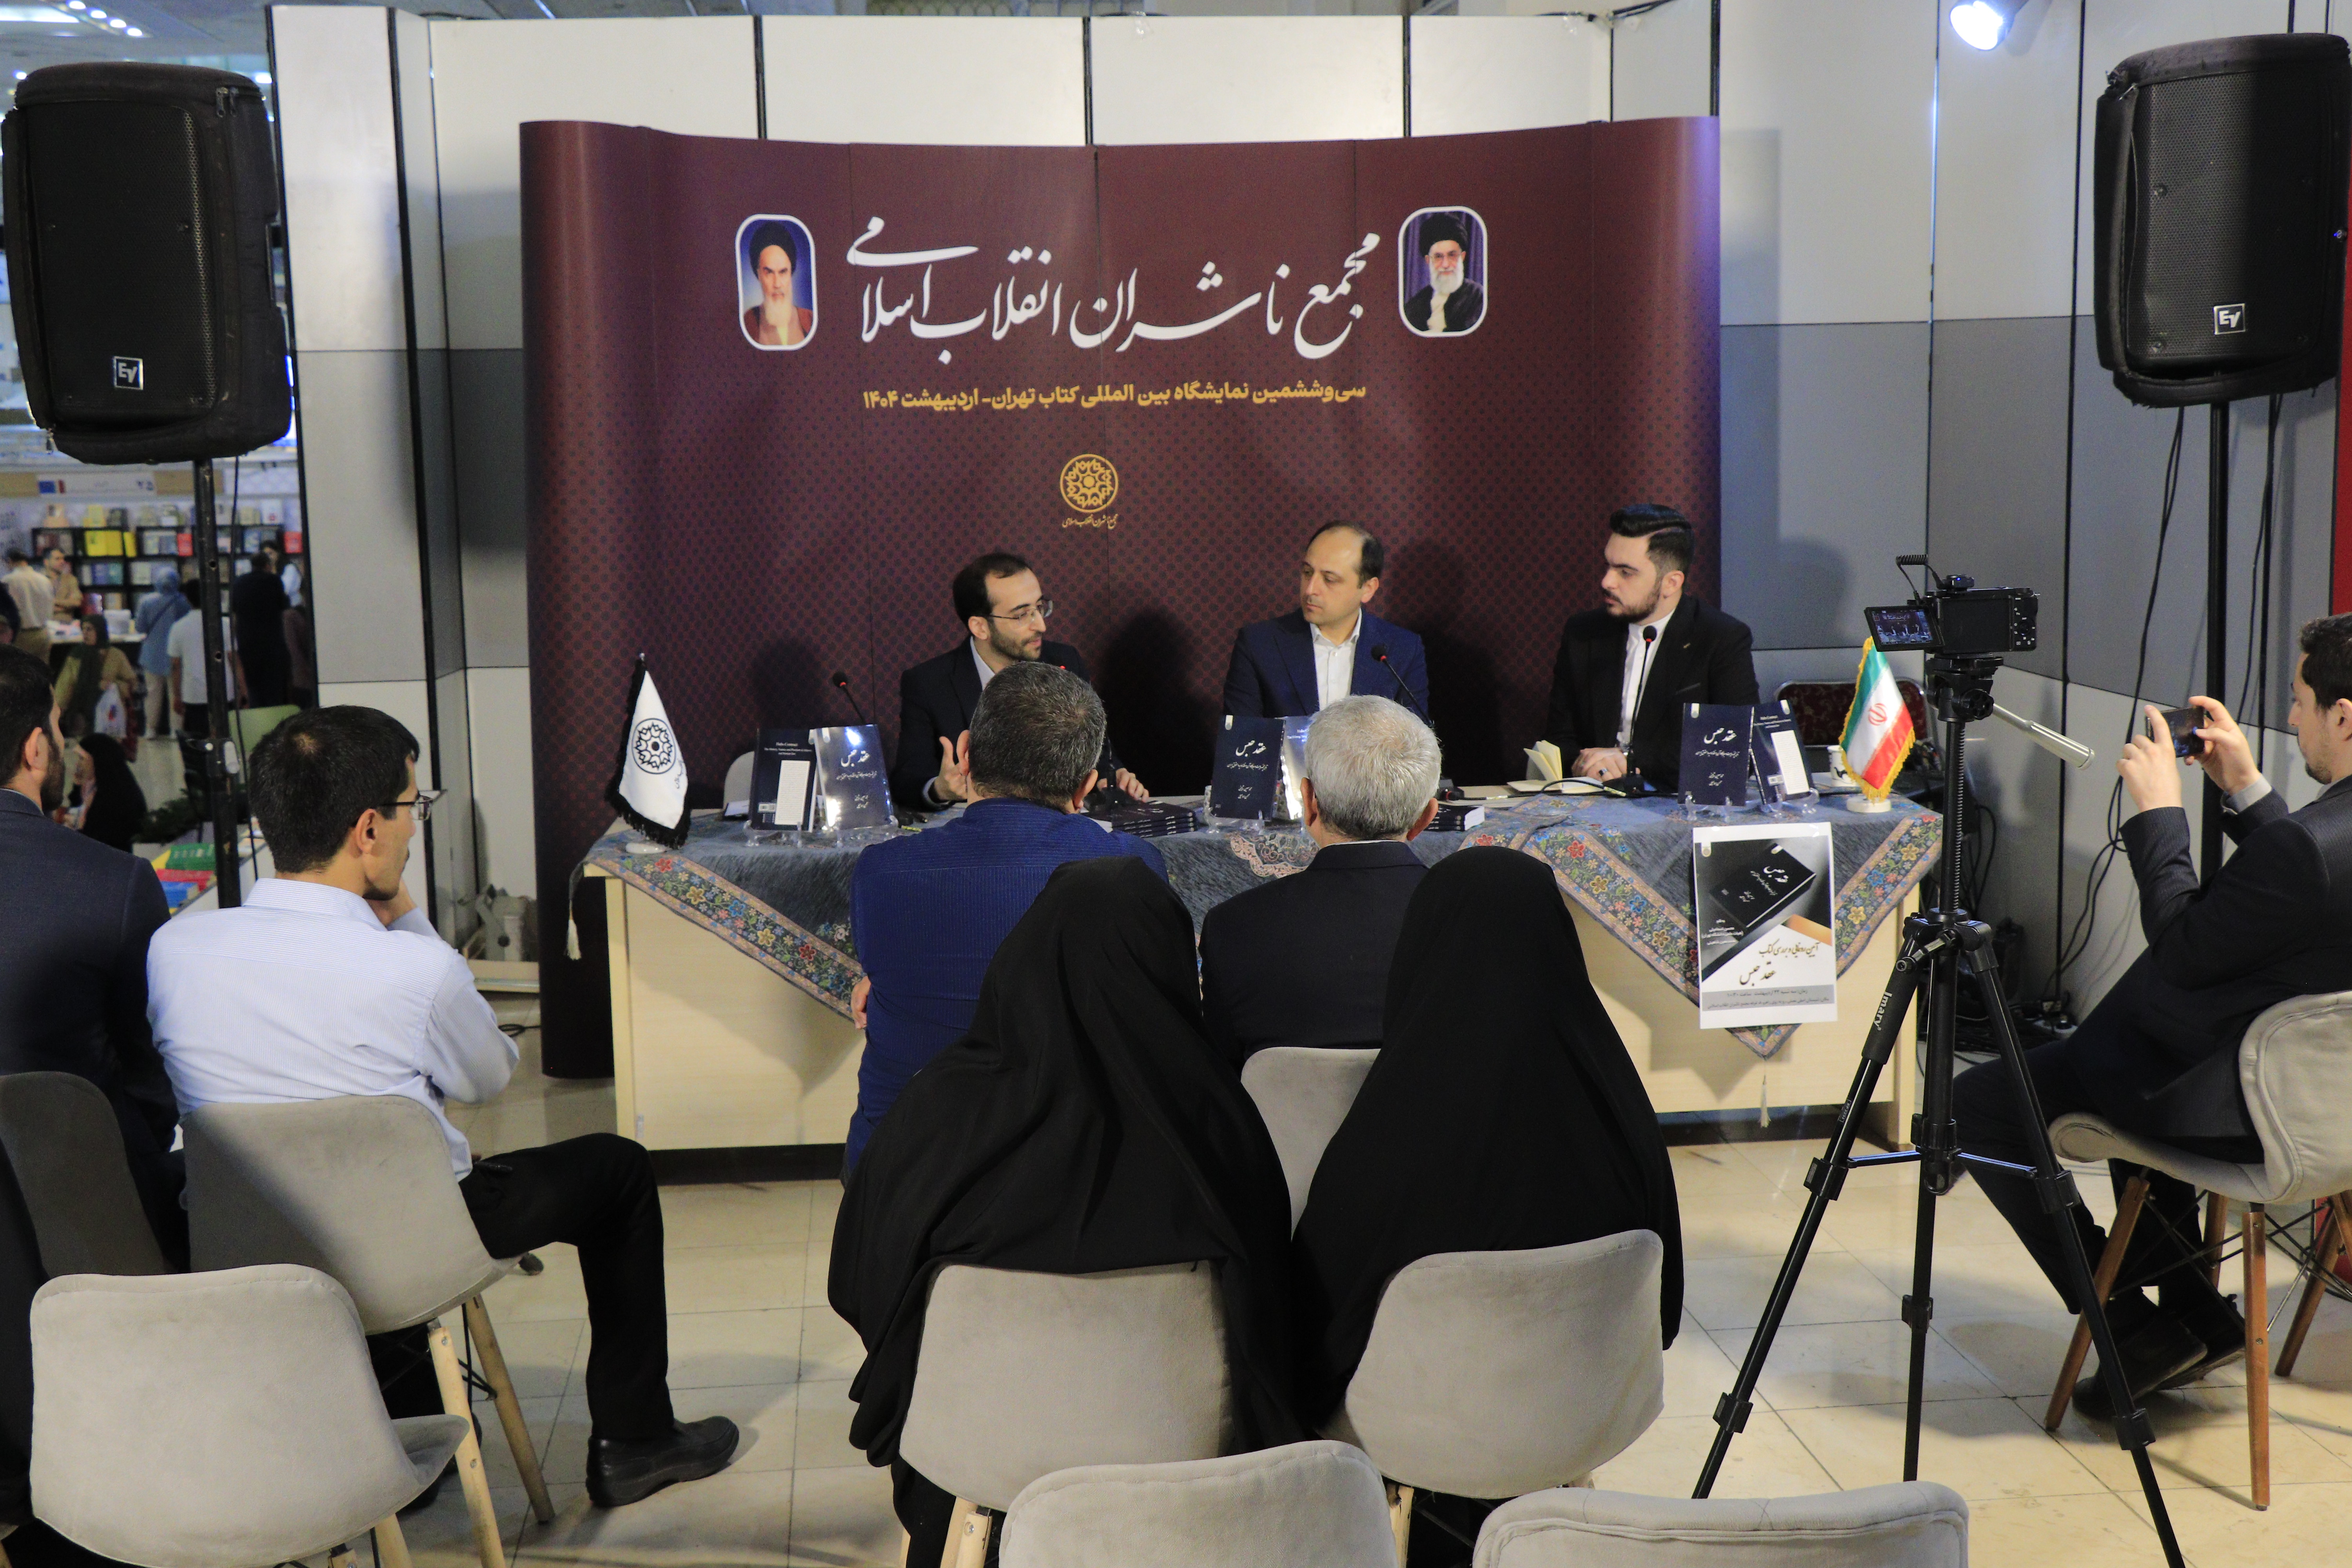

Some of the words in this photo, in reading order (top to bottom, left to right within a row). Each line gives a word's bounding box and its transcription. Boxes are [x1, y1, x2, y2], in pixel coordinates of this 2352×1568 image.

[846, 216, 978, 343] اسلامی
[909, 245, 1063, 365] انقلاب
[1069, 261, 1290, 352] ناشران
[1294, 232, 1380, 359] مجمع
[863, 390, 898, 408] ۱۴۰۴
[902, 388, 979, 411] اردیبهشت
[1038, 385, 1080, 408] کتاب
[1081, 383, 1134, 408] المللی
[1137, 388, 1171, 407] بین
[1174, 380, 1249, 404] نمایشگاه
